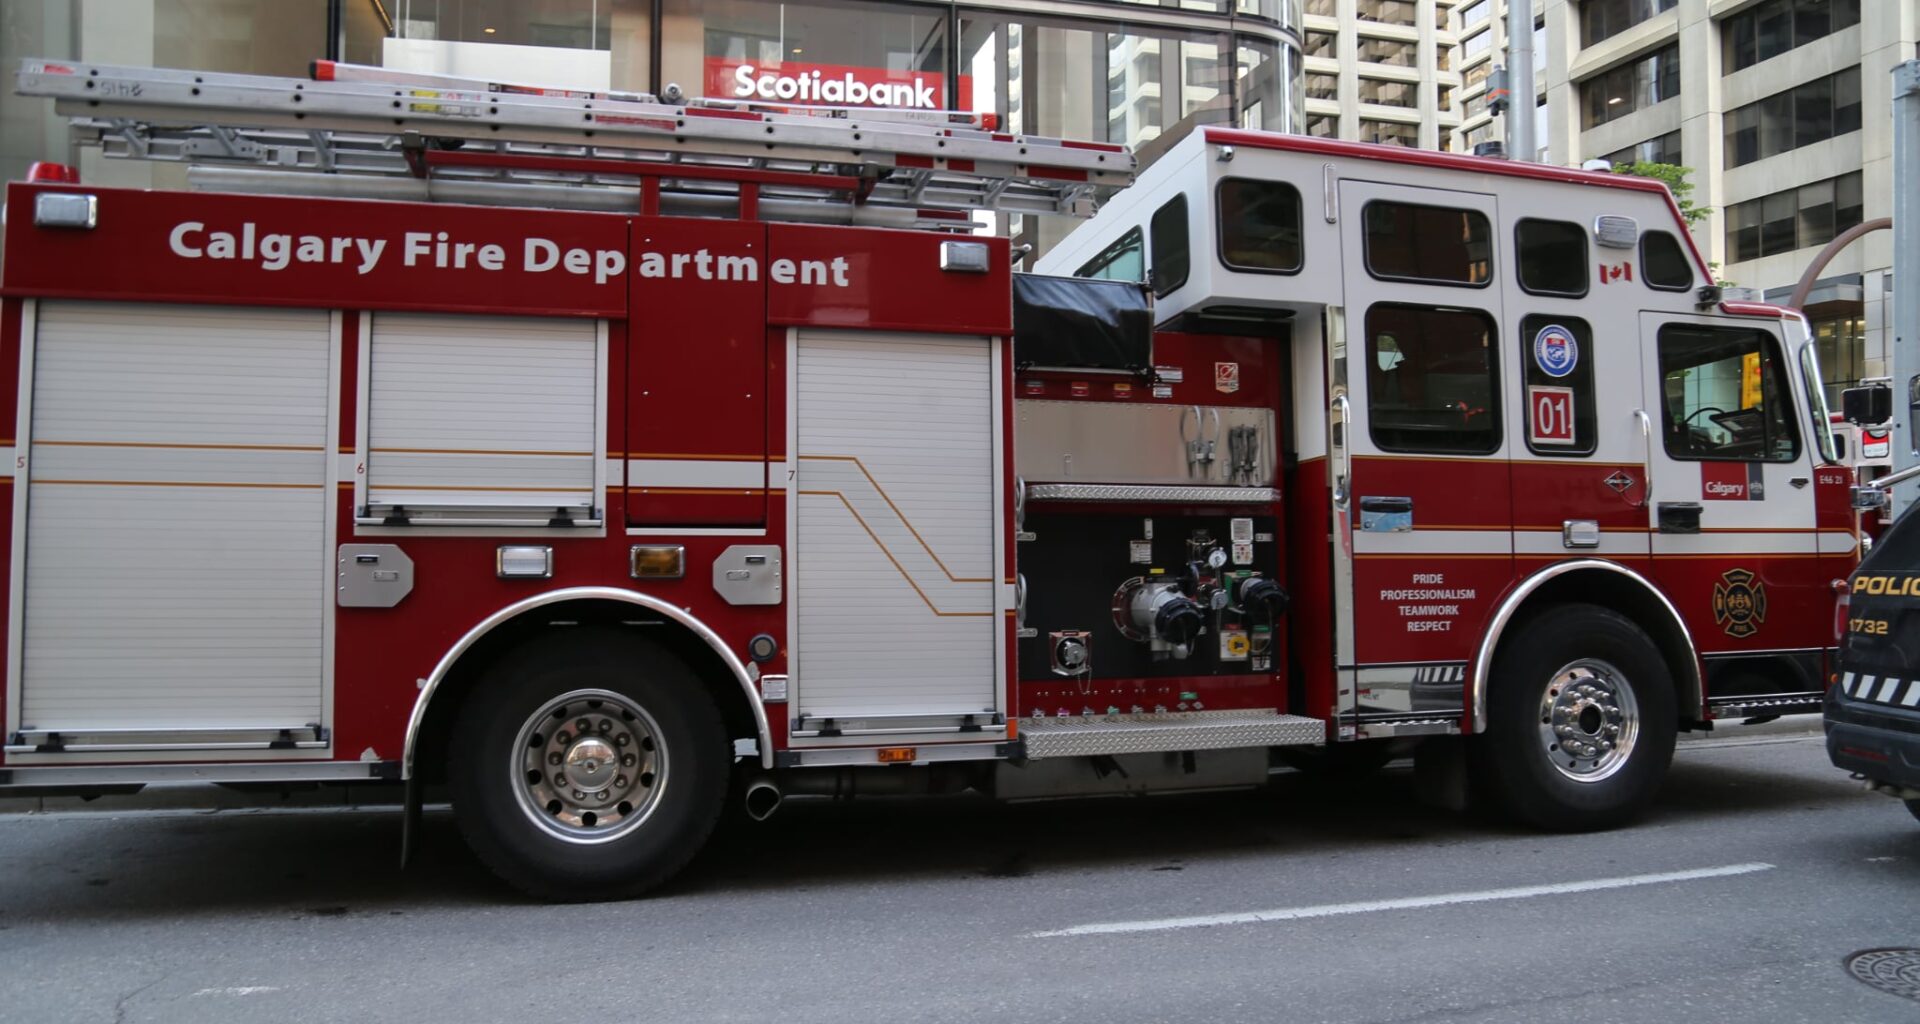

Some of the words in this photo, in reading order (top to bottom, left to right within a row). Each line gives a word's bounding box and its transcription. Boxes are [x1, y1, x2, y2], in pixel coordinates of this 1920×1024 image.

[734, 64, 935, 109] Scotiabank
[169, 221, 387, 275] Calgary
[404, 231, 506, 271] Fire
[1538, 396, 1567, 436] 01
[17, 456, 25, 468] 5
[357, 462, 365, 474] 6
[788, 470, 796, 481] 7
[1705, 481, 1744, 497] Calgary
[1412, 573, 1444, 584] PRIDE
[1380, 589, 1476, 601] PROFESSIONALISM
[1398, 605, 1459, 616] TEAMWORK
[1407, 620, 1452, 632] RESPECT
[1849, 618, 1888, 635] 1732
